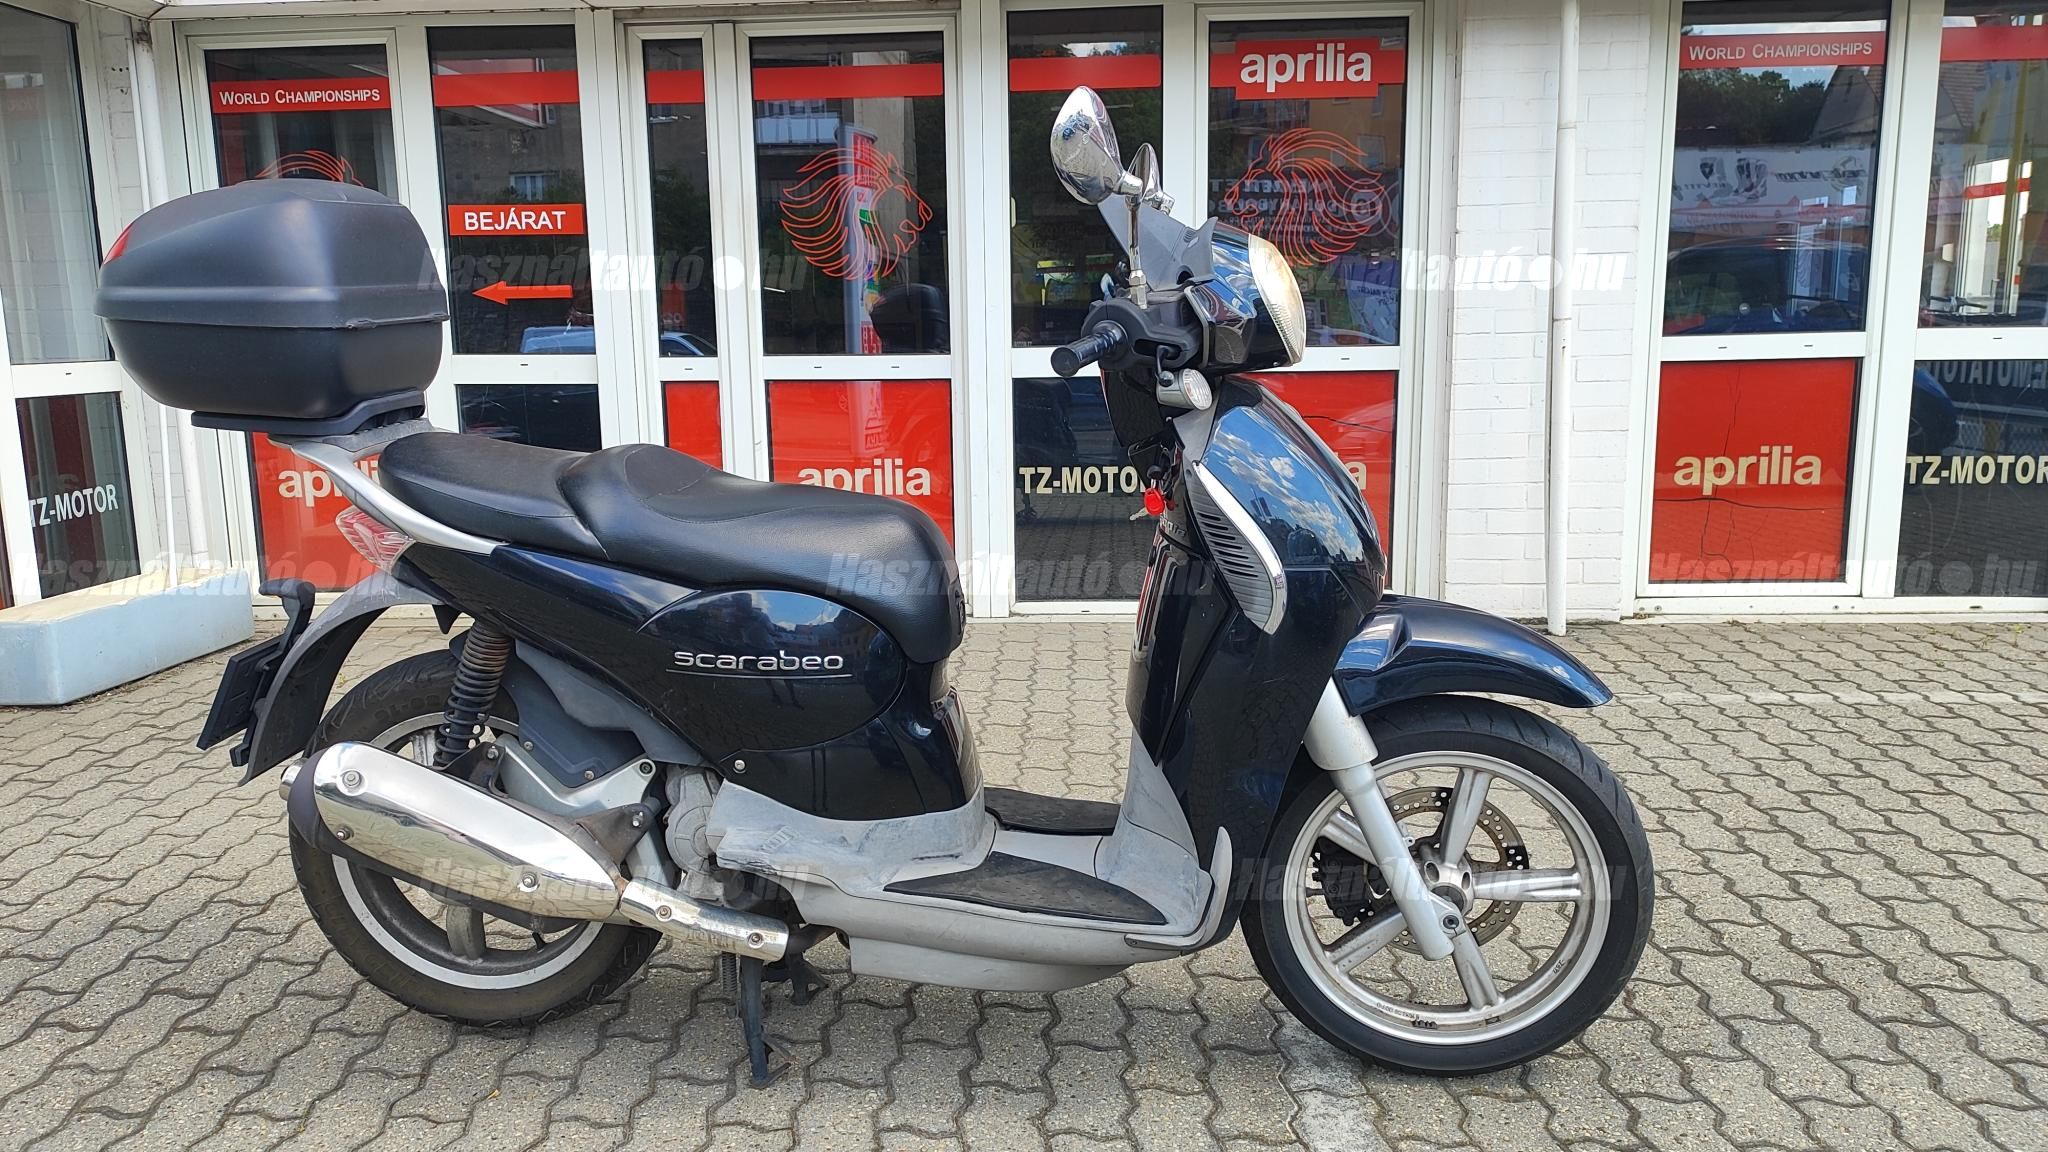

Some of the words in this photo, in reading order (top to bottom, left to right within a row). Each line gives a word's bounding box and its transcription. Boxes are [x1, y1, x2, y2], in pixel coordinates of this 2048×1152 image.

[1689, 45, 1745, 61] WORLD
[1753, 42, 1872, 59] CHAMPIONSHIPS
[1240, 43, 1373, 93] aprilia
[219, 91, 270, 105] WORLD
[275, 89, 380, 104] CHAMPIONSHIPS
[464, 207, 566, 231] BEJÁRAT
[1019, 465, 1145, 494] TZ-MOTO
[1673, 445, 1822, 496] aprilia
[28, 484, 119, 528] TZ-MOTOR
[674, 650, 844, 671] scarabeo
